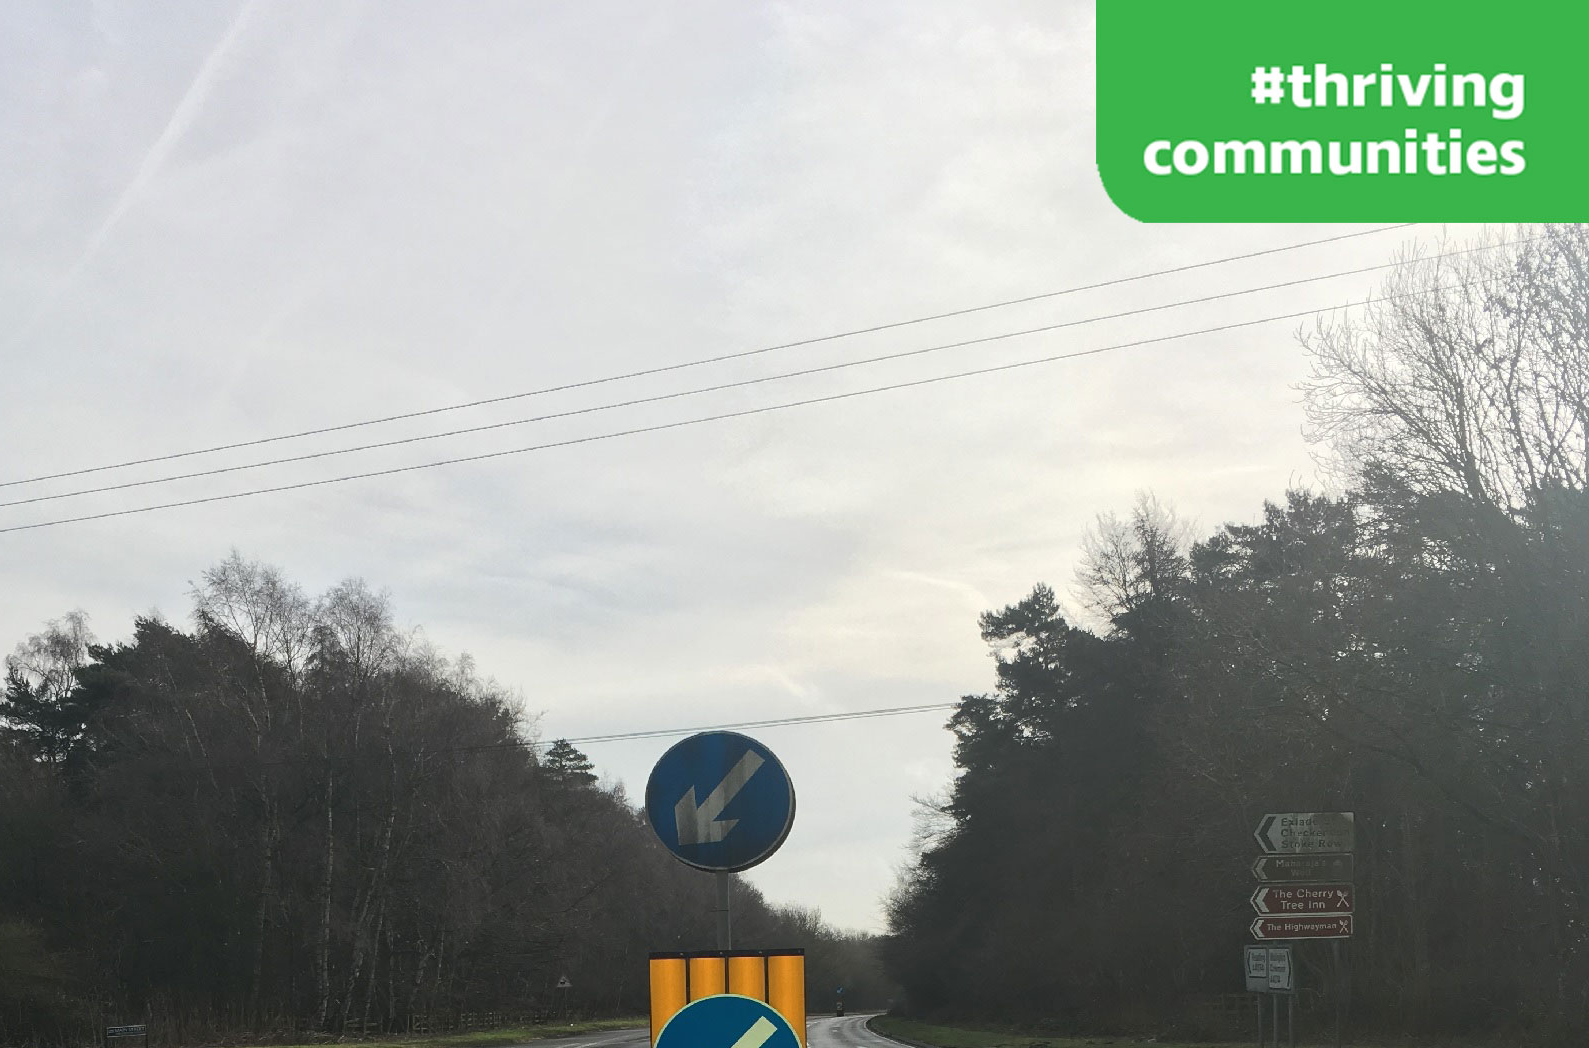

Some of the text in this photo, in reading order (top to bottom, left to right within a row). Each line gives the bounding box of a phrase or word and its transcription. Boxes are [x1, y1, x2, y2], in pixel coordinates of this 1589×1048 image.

[1281, 839, 1341, 849] Stoke Row
[1272, 888, 1334, 900] The Cherry
[1280, 900, 1326, 910] Tree Inn
[1267, 922, 1337, 932] The Highwayman
